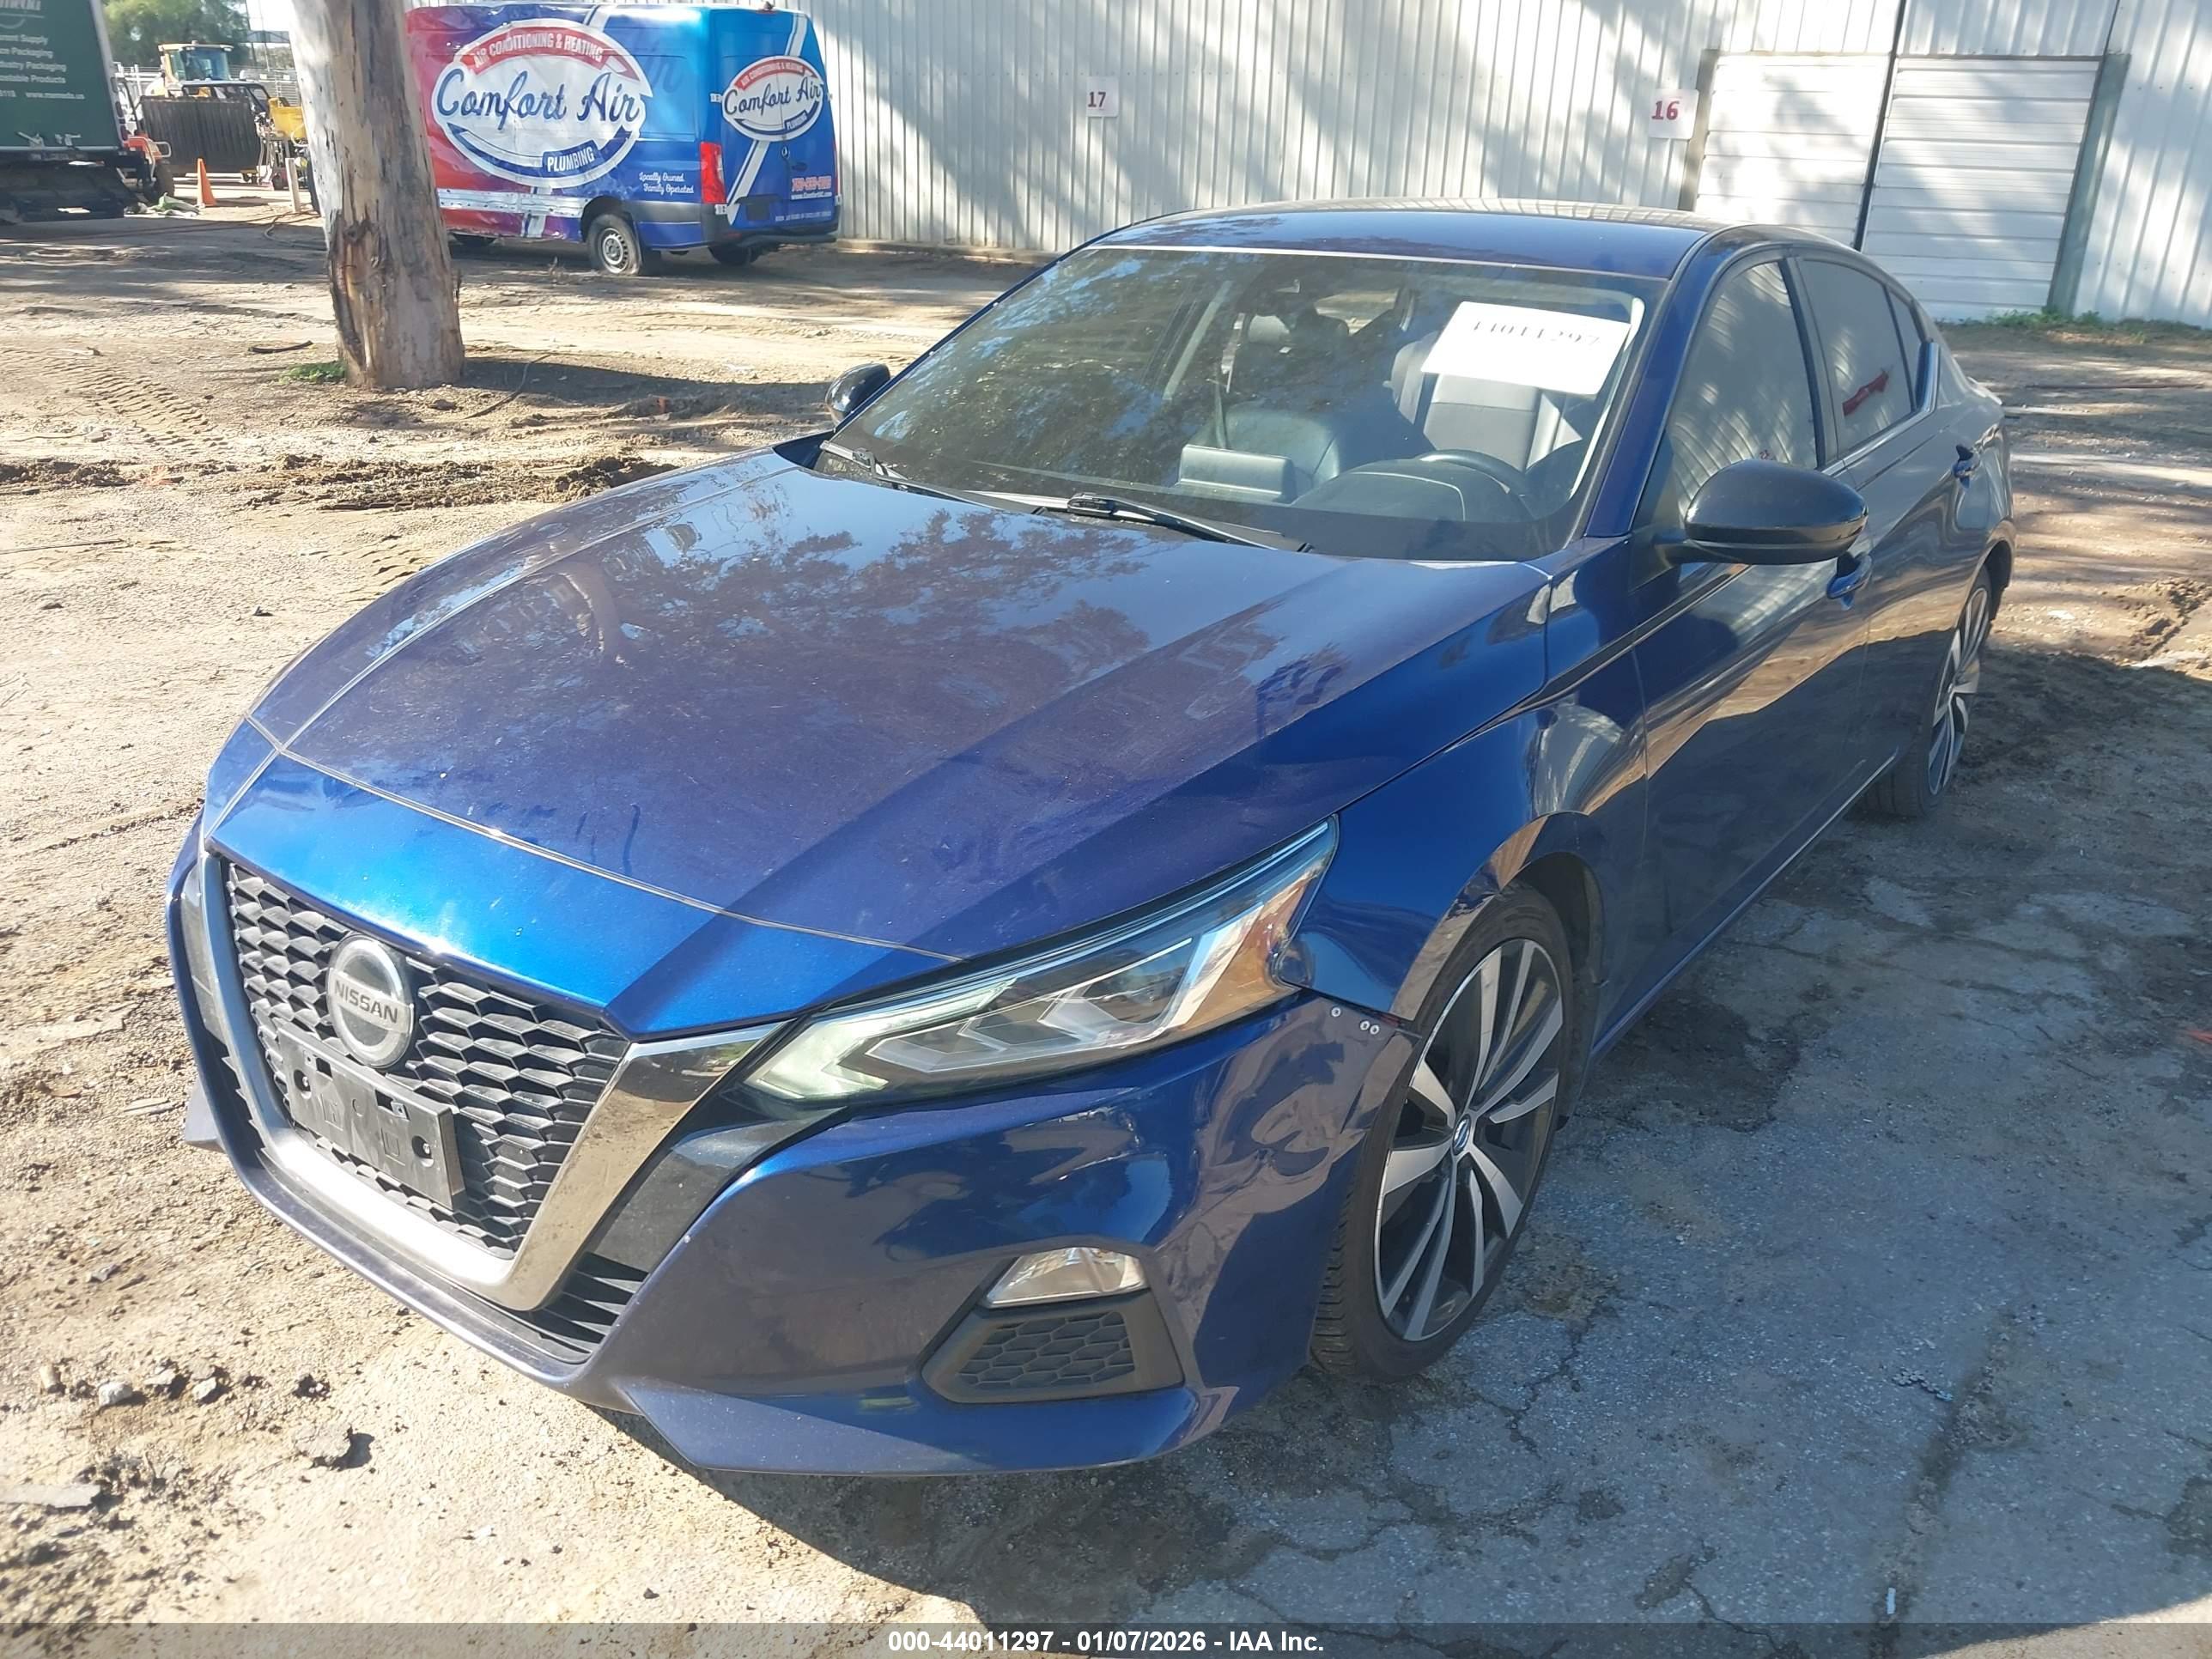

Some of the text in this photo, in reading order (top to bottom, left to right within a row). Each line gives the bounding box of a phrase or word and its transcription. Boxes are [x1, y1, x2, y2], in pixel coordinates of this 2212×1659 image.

[471, 33, 603, 68] AIR CONDITIONING & HEATING
[436, 68, 568, 131] Comfort
[576, 71, 641, 123] Air
[725, 76, 821, 117] Comfort Air
[1087, 91, 1107, 108] 17
[1650, 100, 1680, 121] 16
[547, 146, 595, 173] PLUMBING
[334, 980, 398, 1024] NISSAN
